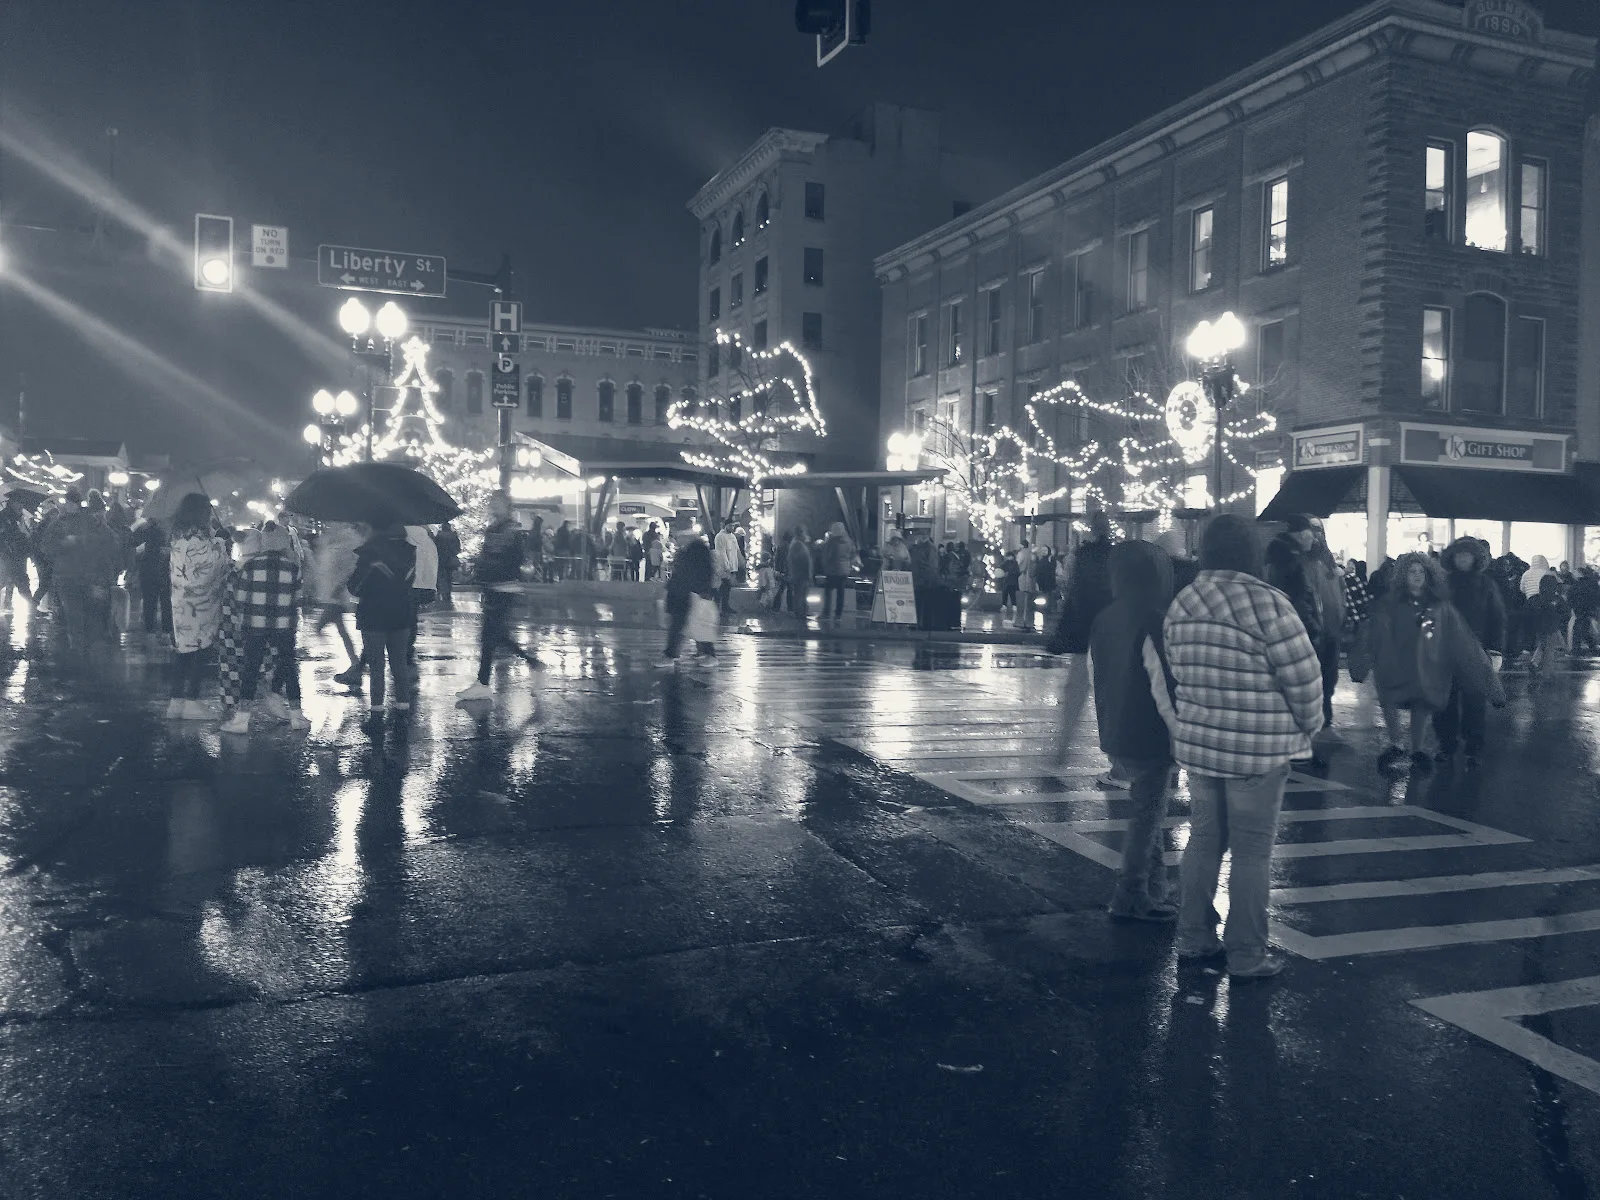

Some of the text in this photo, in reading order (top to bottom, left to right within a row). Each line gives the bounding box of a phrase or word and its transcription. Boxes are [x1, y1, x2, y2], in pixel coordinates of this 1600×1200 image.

[262, 228, 278, 238] NO
[260, 238, 281, 246] TURN
[255, 246, 285, 255] ON RED
[329, 249, 435, 277] Liberty St.
[358, 276, 407, 288] WEST EAST
[494, 302, 518, 332] H
[502, 360, 511, 371] P
[493, 388, 519, 396] Parking
[1467, 442, 1493, 456] GIFT
[1496, 444, 1526, 458] SHOP
